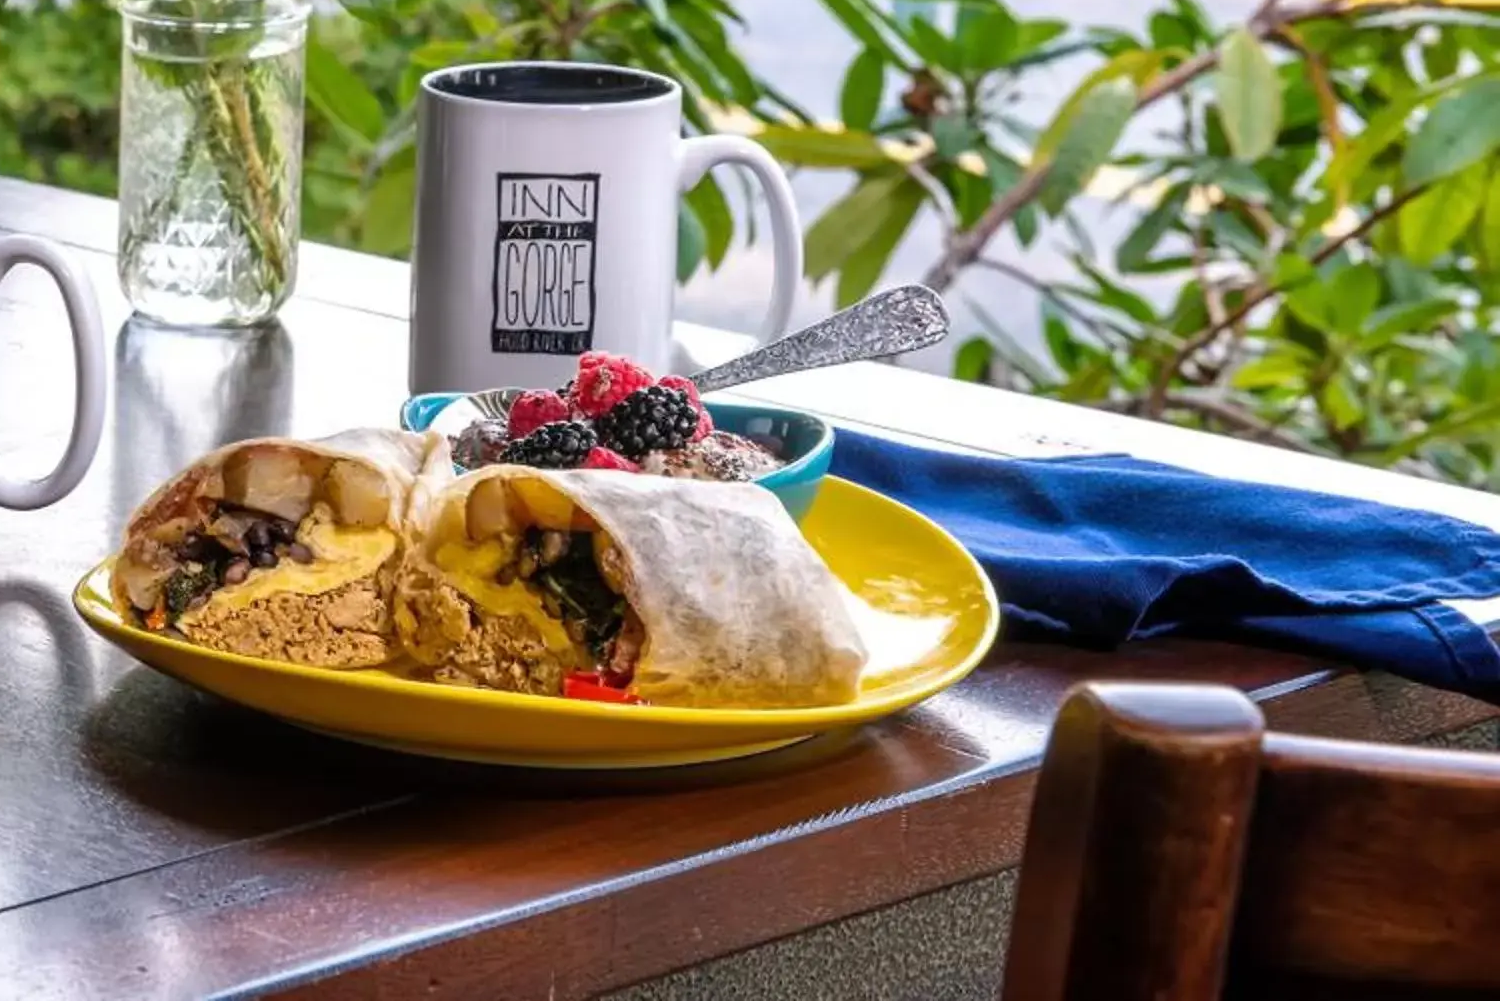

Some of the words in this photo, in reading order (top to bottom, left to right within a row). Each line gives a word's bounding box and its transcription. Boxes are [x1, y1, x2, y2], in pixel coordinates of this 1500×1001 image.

[511, 183, 588, 218] INN
[507, 222, 540, 238] AT
[543, 223, 585, 239] THE
[505, 242, 587, 328] GORGE
[533, 332, 566, 353] RIVER
